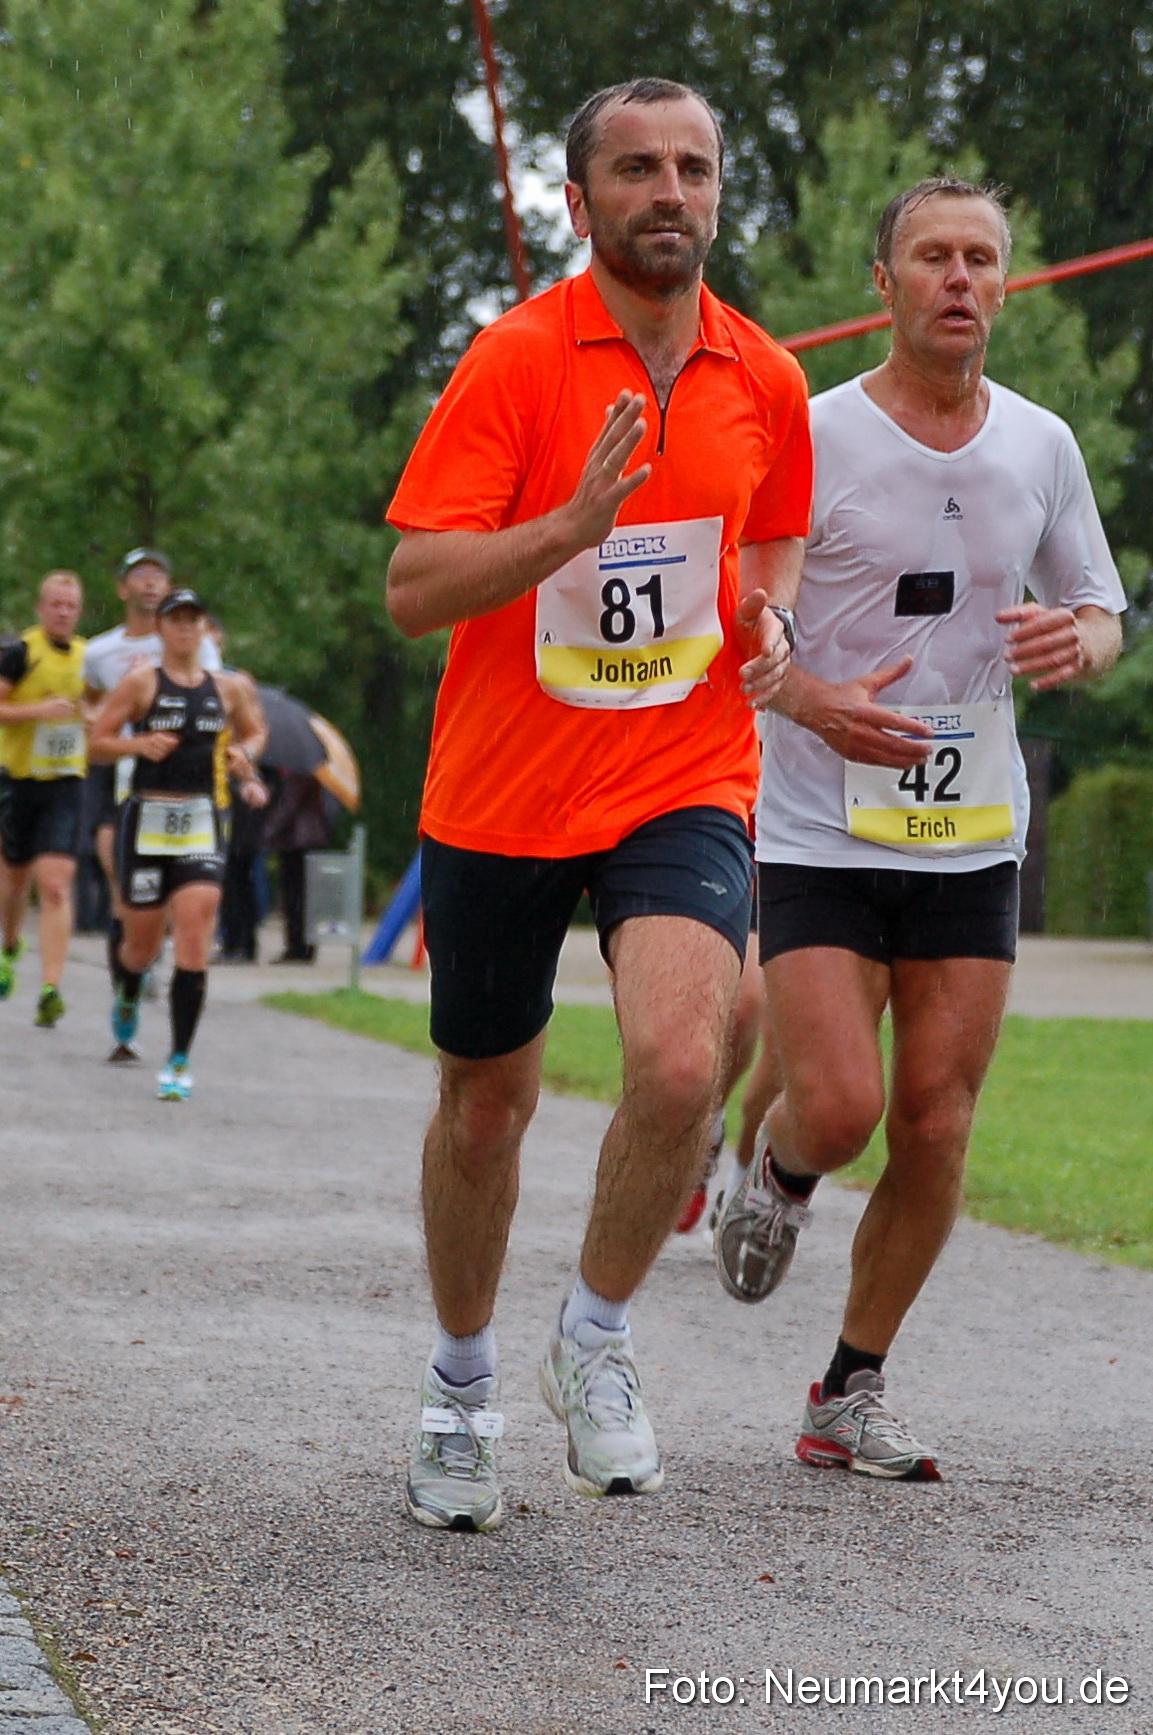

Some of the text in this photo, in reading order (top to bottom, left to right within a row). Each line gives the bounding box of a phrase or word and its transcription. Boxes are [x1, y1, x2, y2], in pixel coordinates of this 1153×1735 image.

[599, 536, 667, 559] BOCK
[600, 574, 665, 643] 81
[543, 632, 552, 644] A
[590, 655, 673, 683] Johann
[909, 714, 962, 731] OCK
[898, 746, 962, 802] 42
[165, 811, 193, 835] 86
[906, 816, 957, 838] Erich
